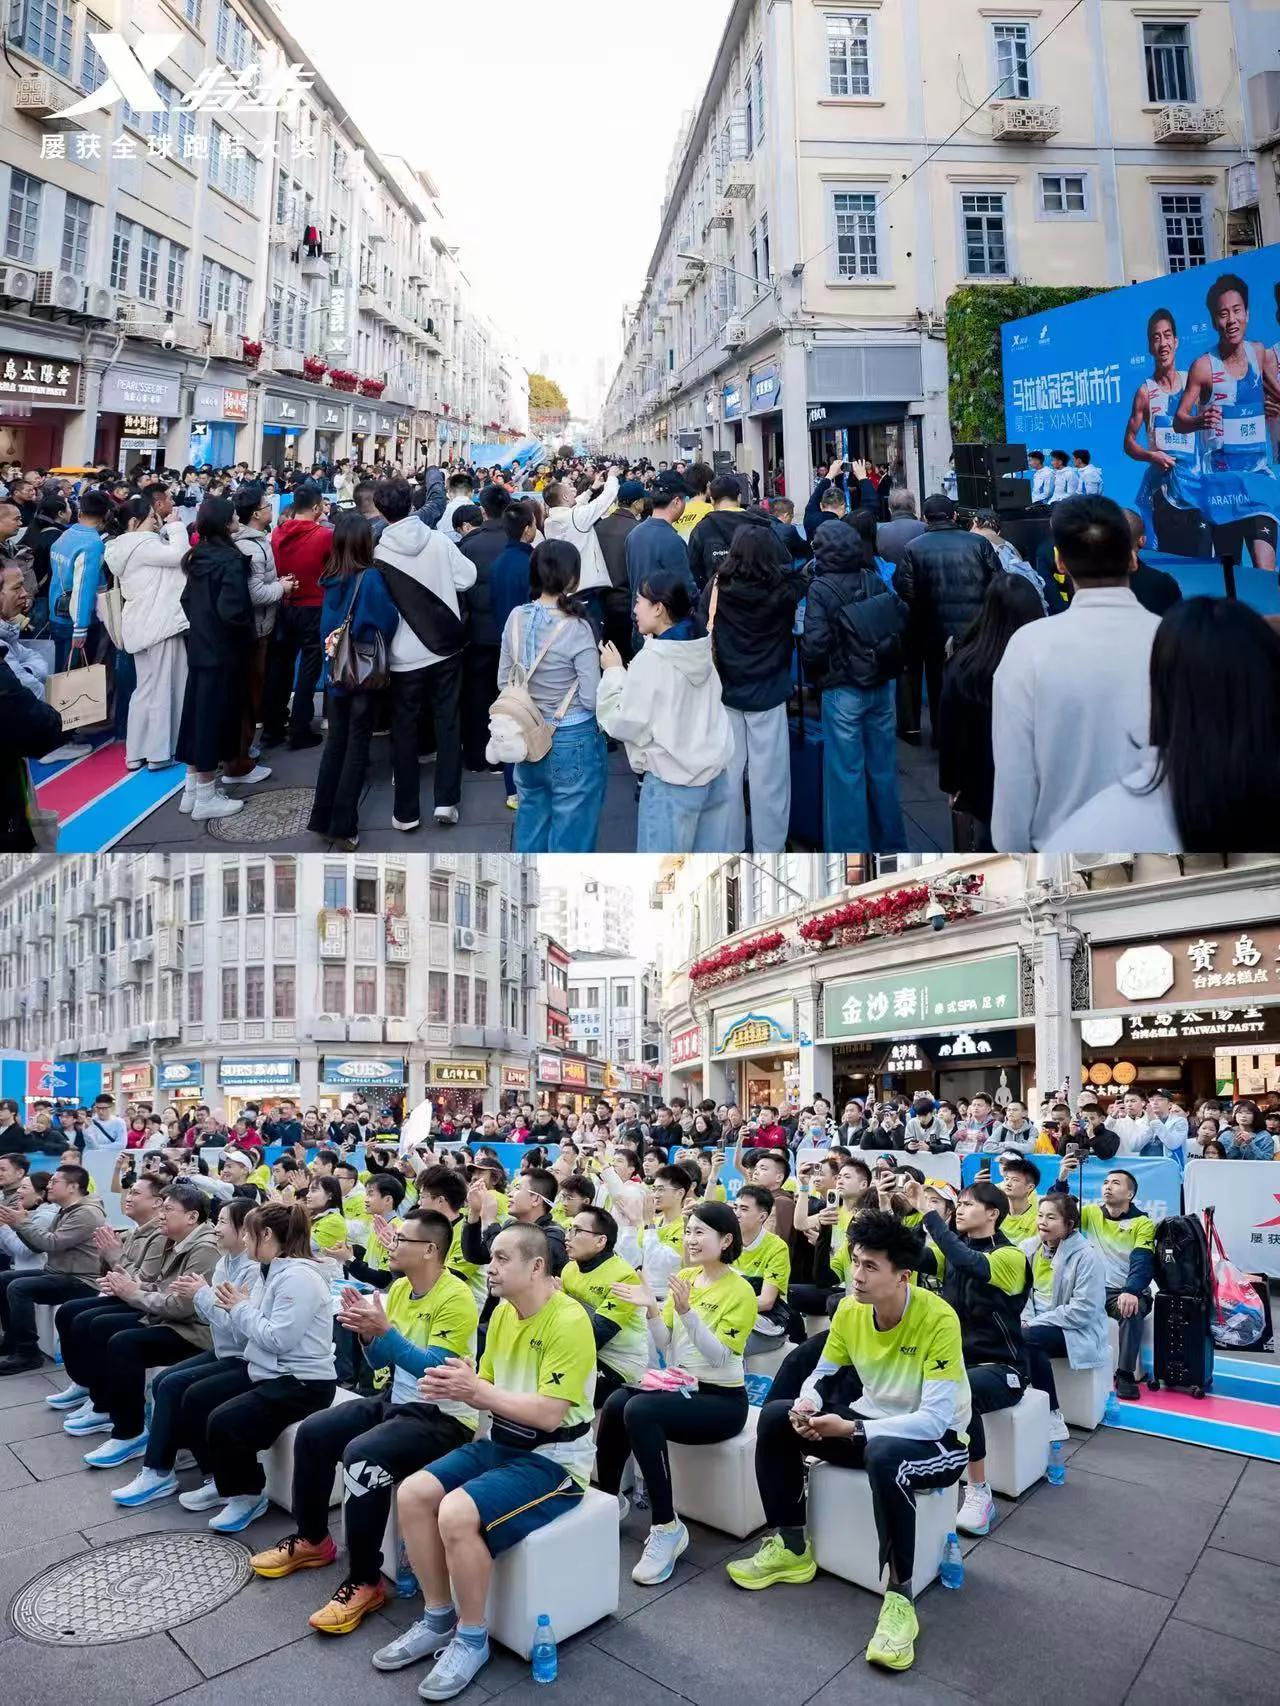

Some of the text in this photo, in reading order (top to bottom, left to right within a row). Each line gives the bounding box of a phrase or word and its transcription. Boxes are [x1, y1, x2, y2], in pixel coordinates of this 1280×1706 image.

[1013, 365, 1120, 411] 马拉松冠军城市行
[1050, 411, 1092, 430] XIAMEN
[842, 987, 917, 1025] 金沙泰
[1181, 1024, 1226, 1036] TAIWAN
[1227, 1021, 1265, 1033] PASTY
